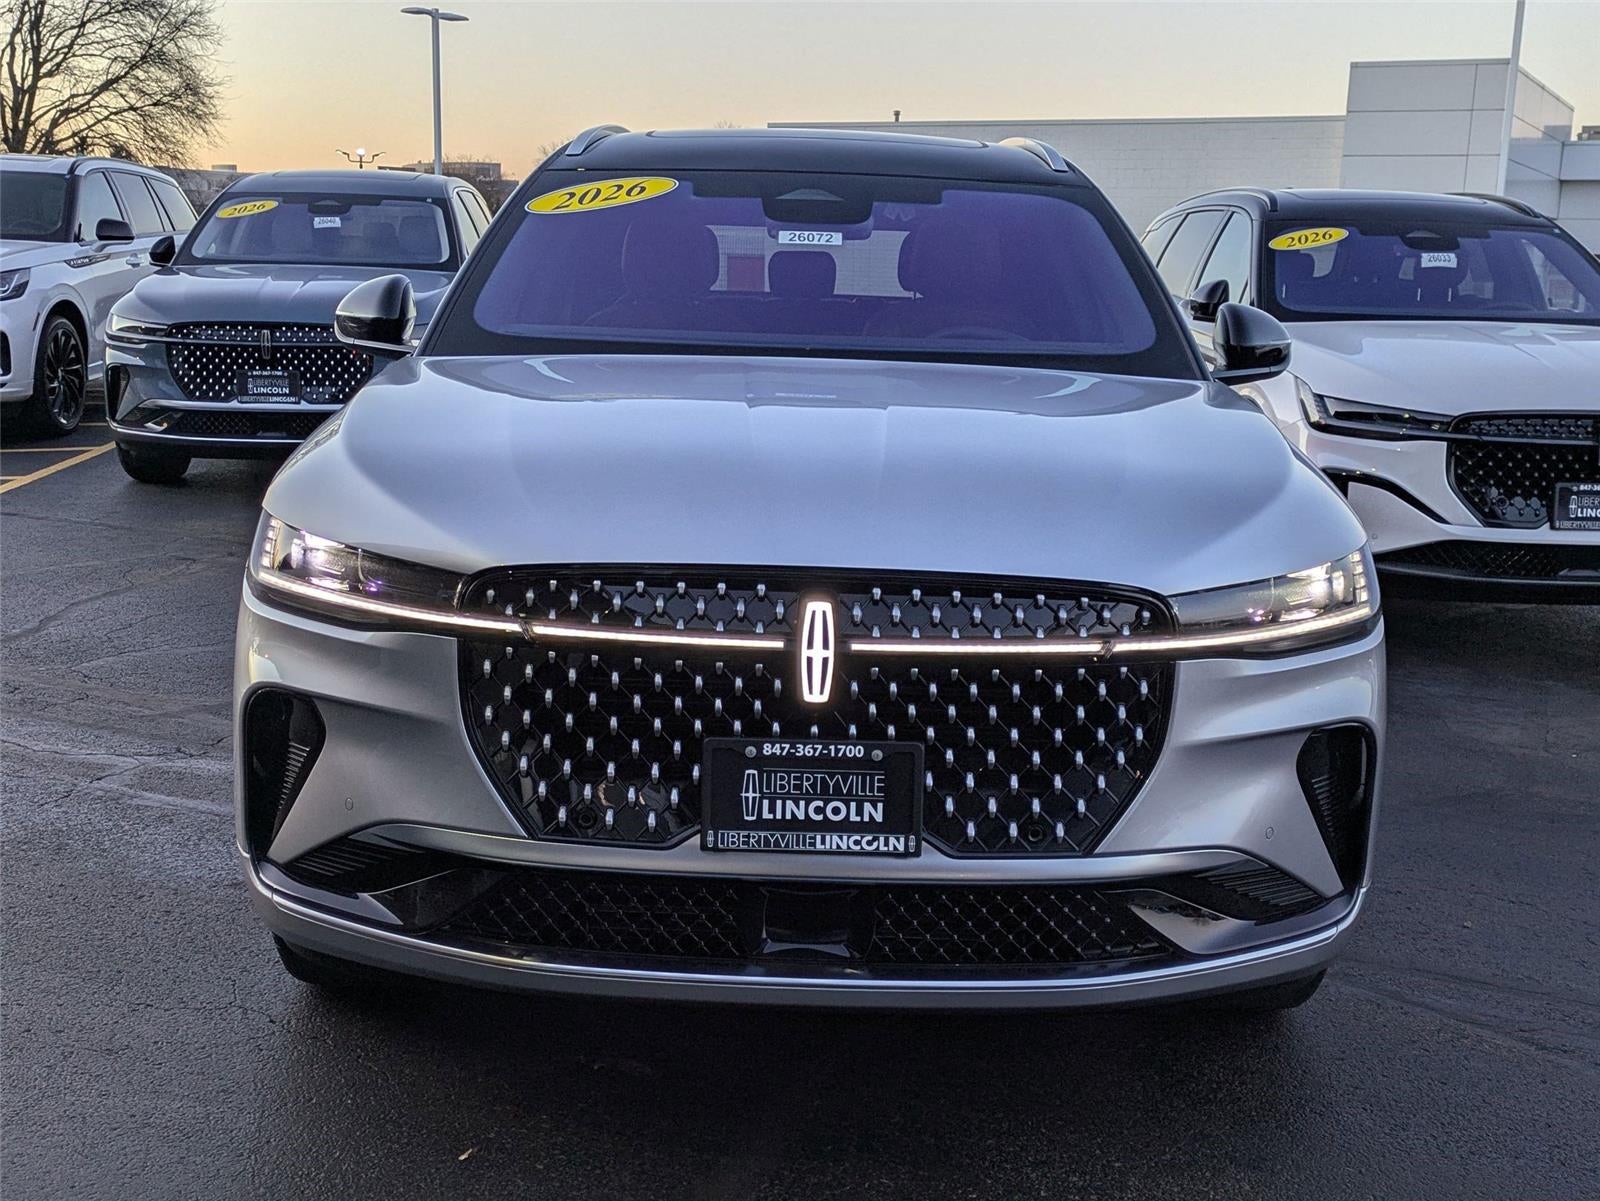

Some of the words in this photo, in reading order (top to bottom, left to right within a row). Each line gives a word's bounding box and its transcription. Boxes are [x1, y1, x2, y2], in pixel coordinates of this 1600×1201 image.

[551, 179, 647, 211] 2026
[226, 203, 266, 217] 2026
[788, 231, 833, 244] 26072
[1287, 230, 1333, 248] 2026
[1427, 254, 1452, 263] 26033
[253, 386, 289, 394] LINCOLN
[762, 743, 865, 758] 847-367-1700
[763, 772, 886, 796] LIBERTYVILLE
[762, 799, 884, 823] LINCOLN
